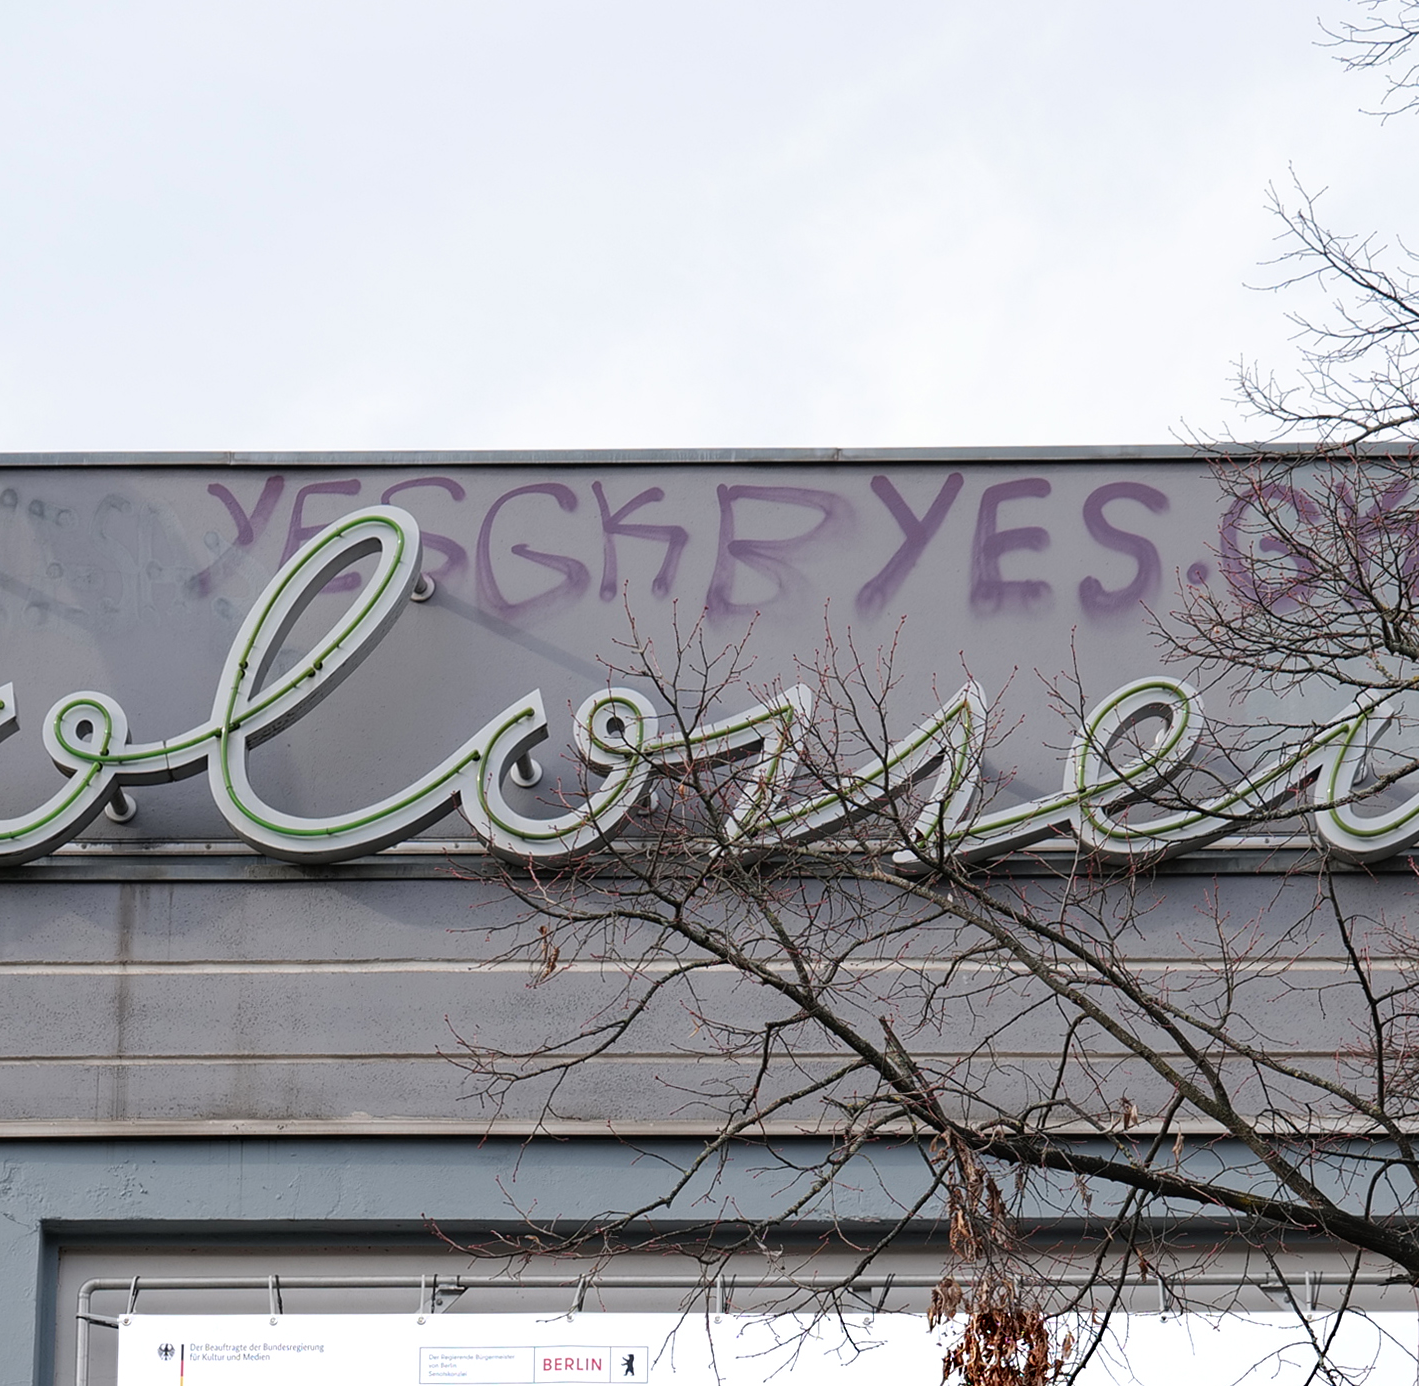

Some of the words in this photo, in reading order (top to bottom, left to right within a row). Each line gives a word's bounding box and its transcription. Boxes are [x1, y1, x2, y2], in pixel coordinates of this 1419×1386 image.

[190, 1343, 203, 1351] Der
[205, 1343, 247, 1353] Beauftragte
[249, 1343, 261, 1351] der
[263, 1343, 324, 1353] Bundesregierung
[190, 1353, 200, 1361] für
[202, 1353, 224, 1361] Kultur
[227, 1353, 241, 1361] und
[243, 1353, 270, 1361] Medien
[543, 1357, 602, 1371] BERLIN
